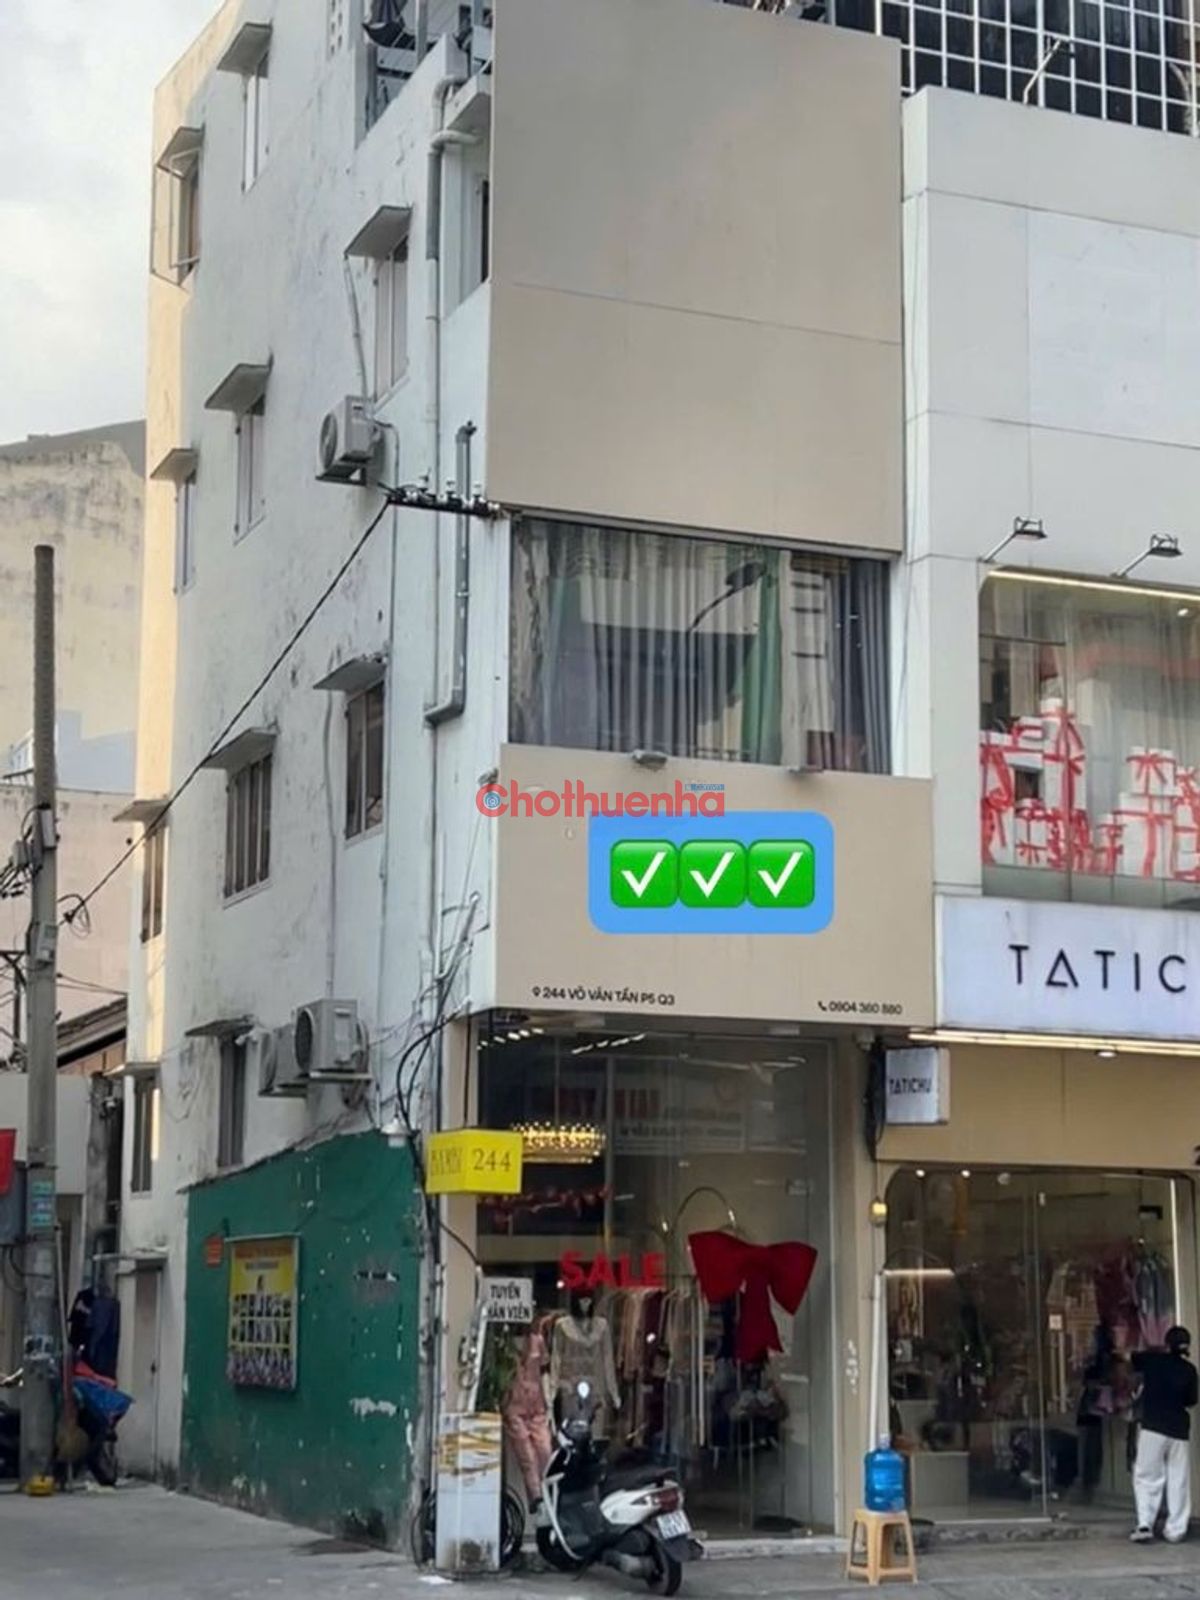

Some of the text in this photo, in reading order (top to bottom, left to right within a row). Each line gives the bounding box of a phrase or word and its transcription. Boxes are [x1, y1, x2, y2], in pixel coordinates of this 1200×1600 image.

[1008, 943, 1187, 993] TATIC
[542, 986, 566, 999] 244
[657, 994, 675, 1006] Q3
[472, 1148, 512, 1172] 244
[560, 1250, 666, 1290] SALE
